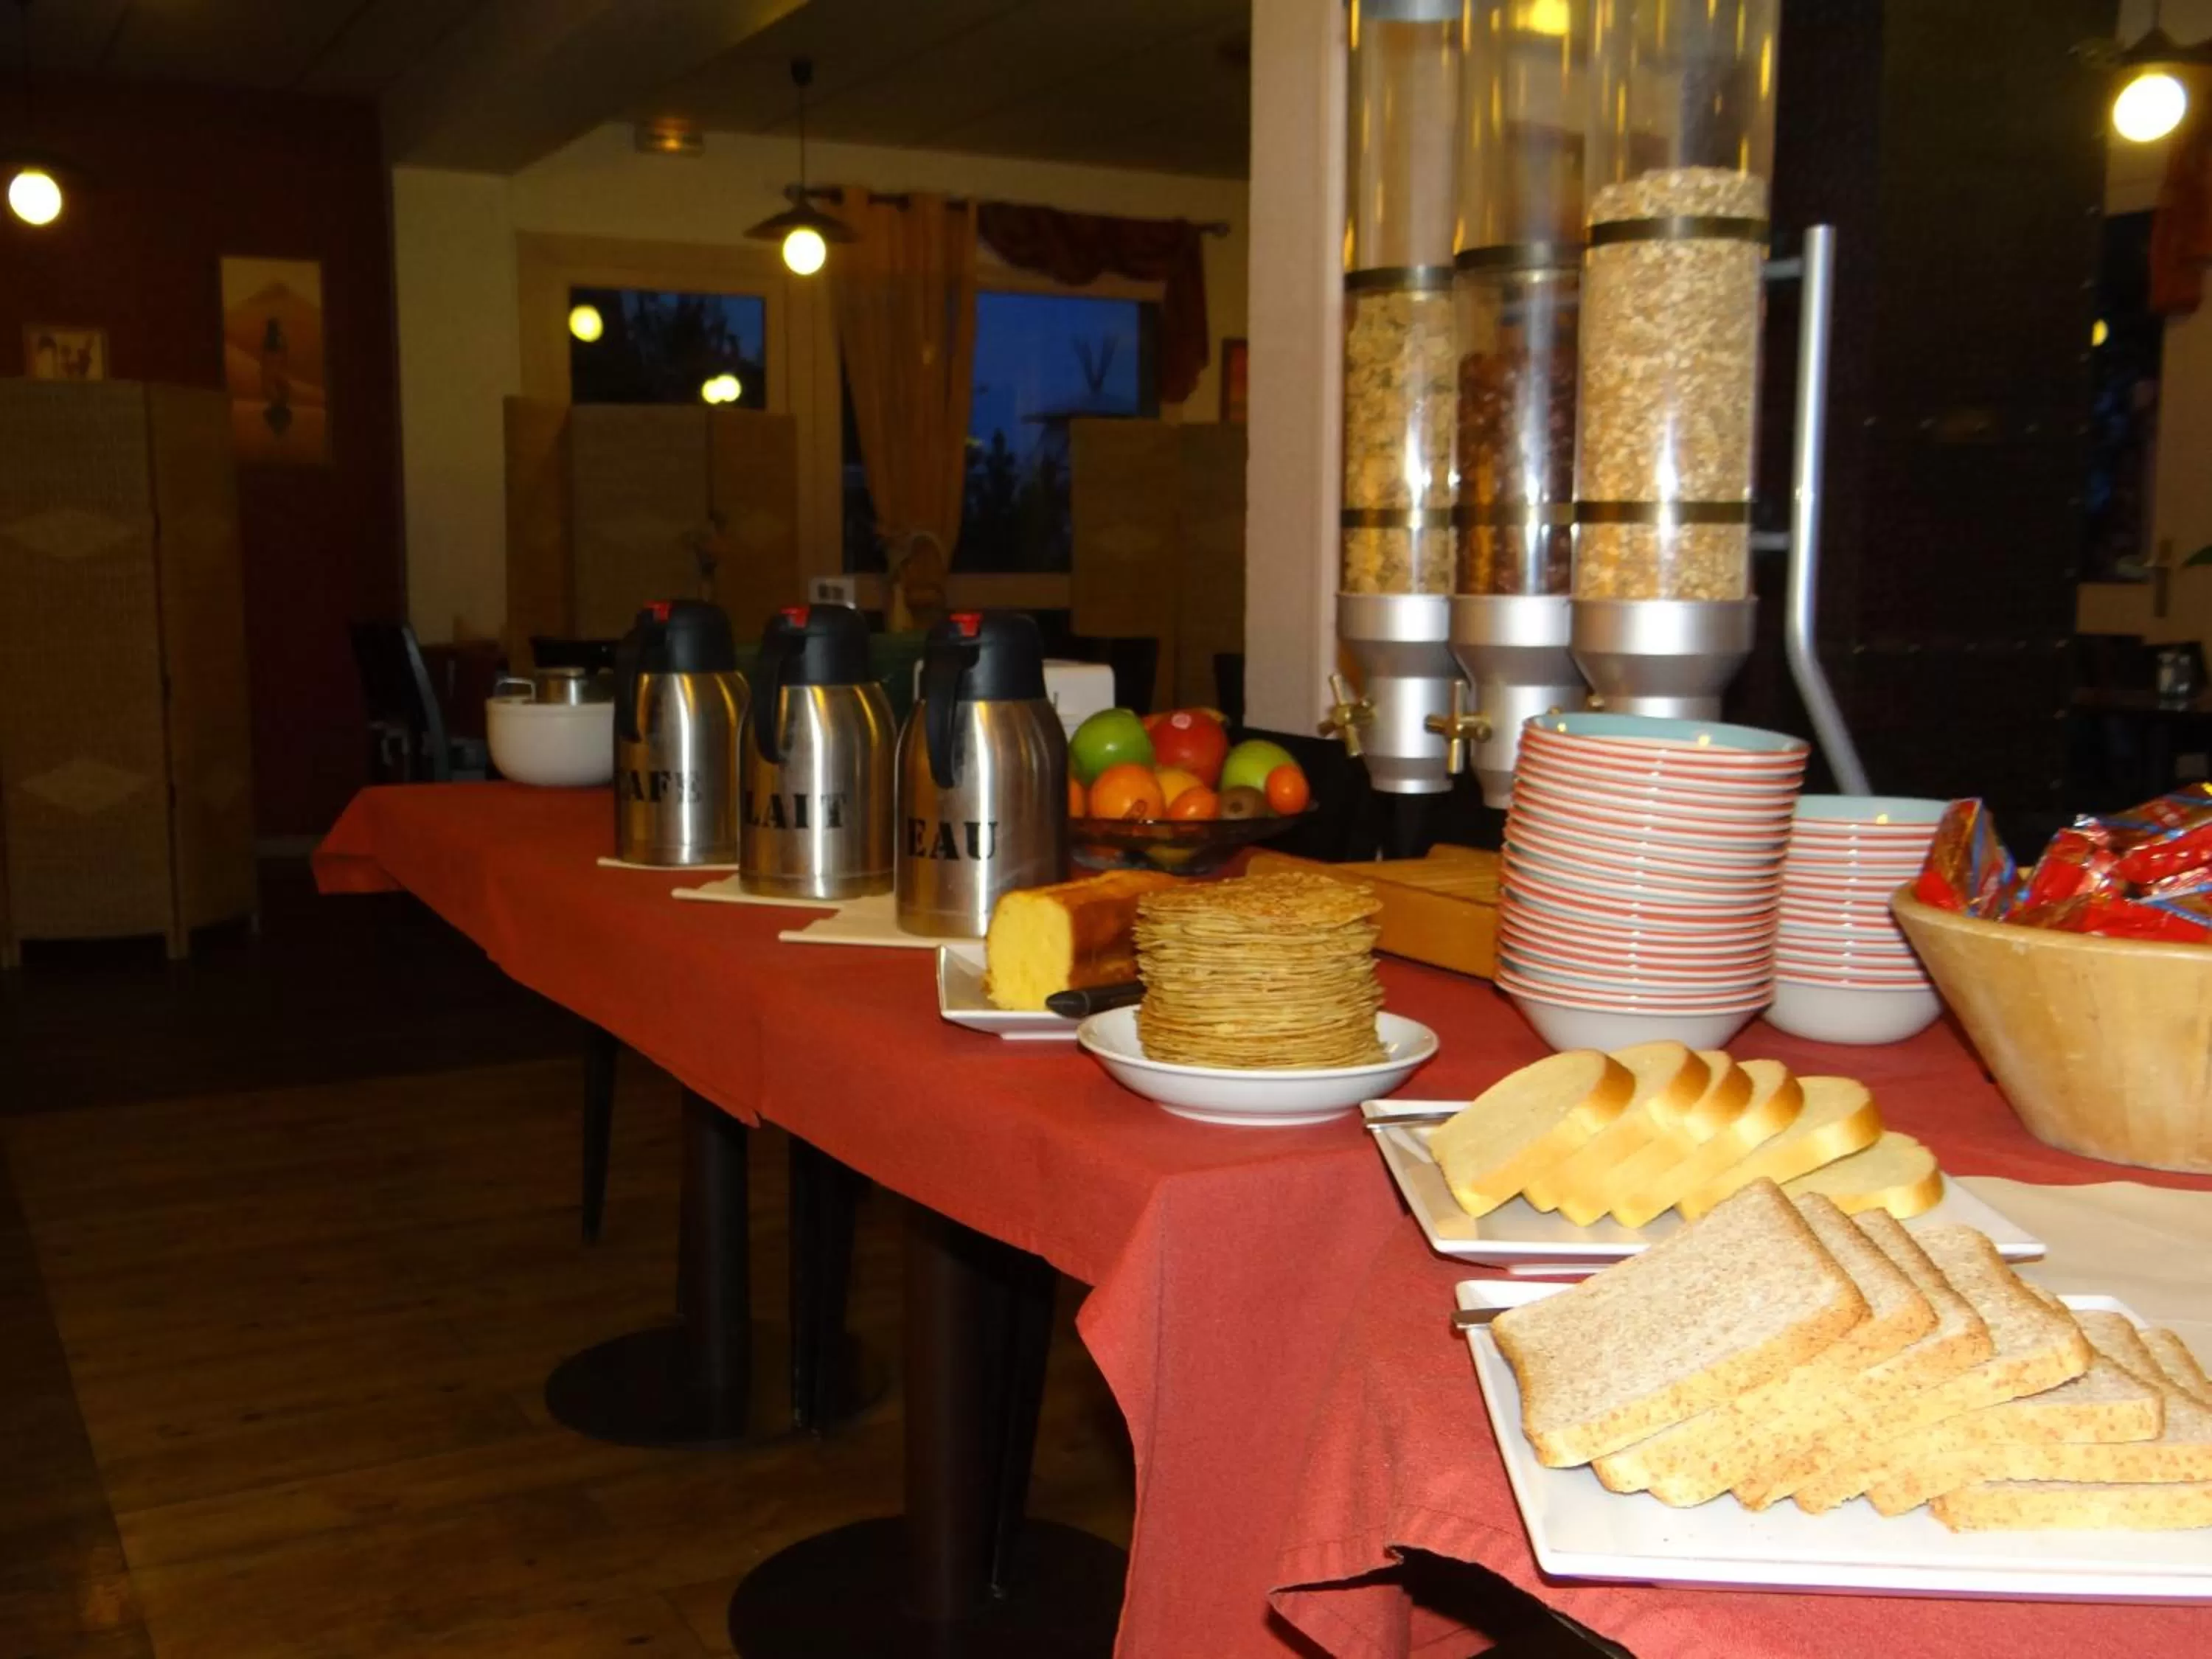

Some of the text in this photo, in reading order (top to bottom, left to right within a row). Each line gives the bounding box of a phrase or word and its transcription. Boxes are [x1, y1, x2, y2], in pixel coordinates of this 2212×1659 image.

[618, 770, 703, 803] AFE
[743, 790, 847, 829] LAIT
[908, 818, 998, 860] EAU
